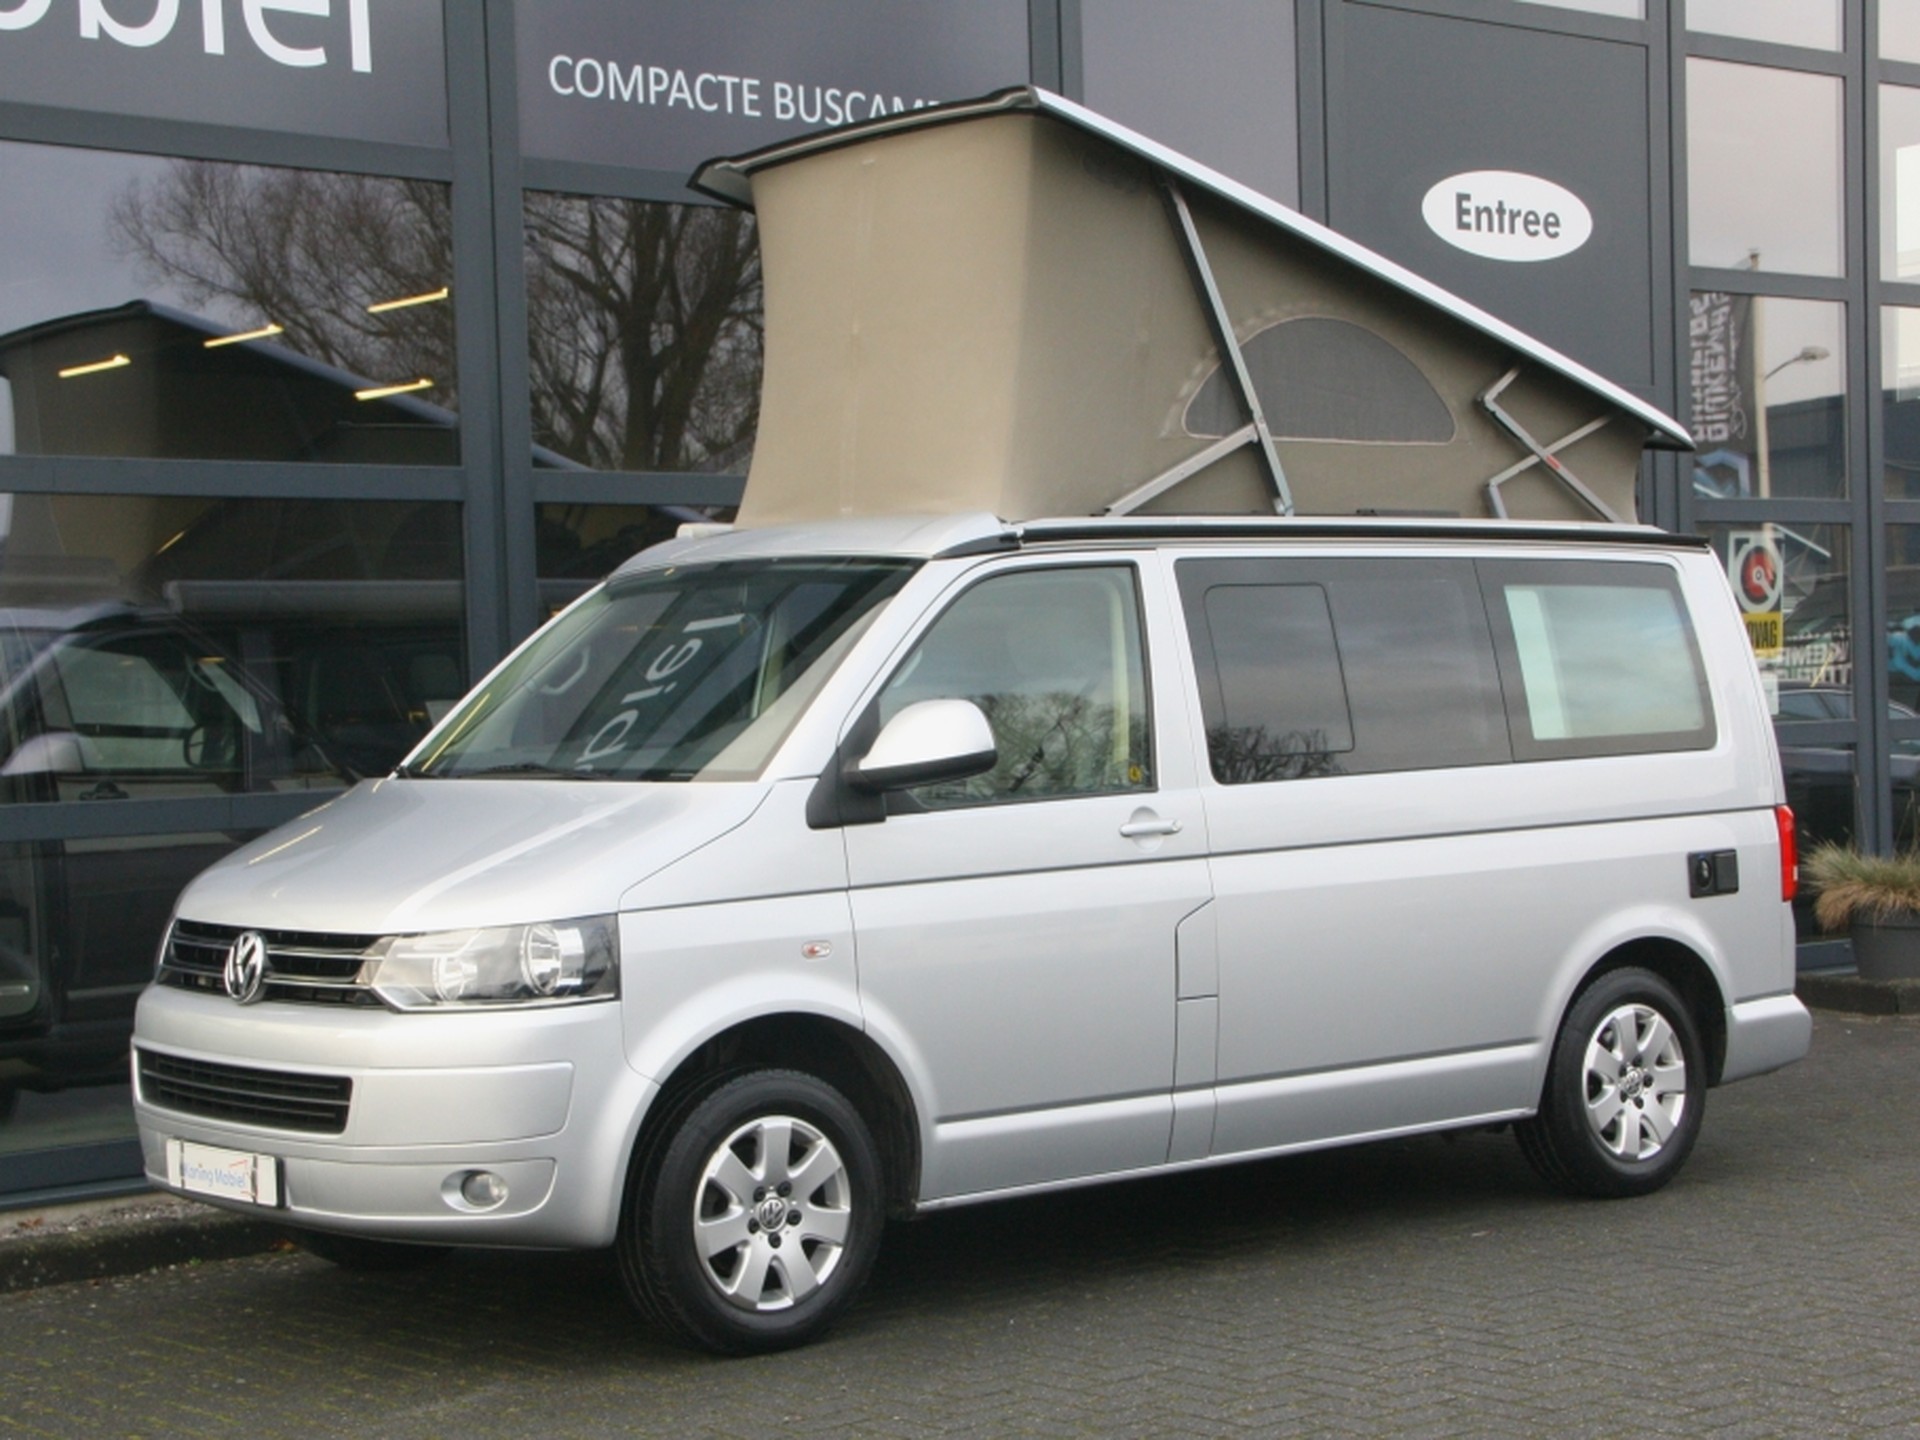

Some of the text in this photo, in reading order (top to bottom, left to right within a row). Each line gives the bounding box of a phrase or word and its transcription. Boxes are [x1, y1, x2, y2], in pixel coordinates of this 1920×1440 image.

[548, 54, 941, 126] COMPACTE BUSCA
[1455, 192, 1562, 239] Entree
[1747, 620, 1777, 650] OVAG
